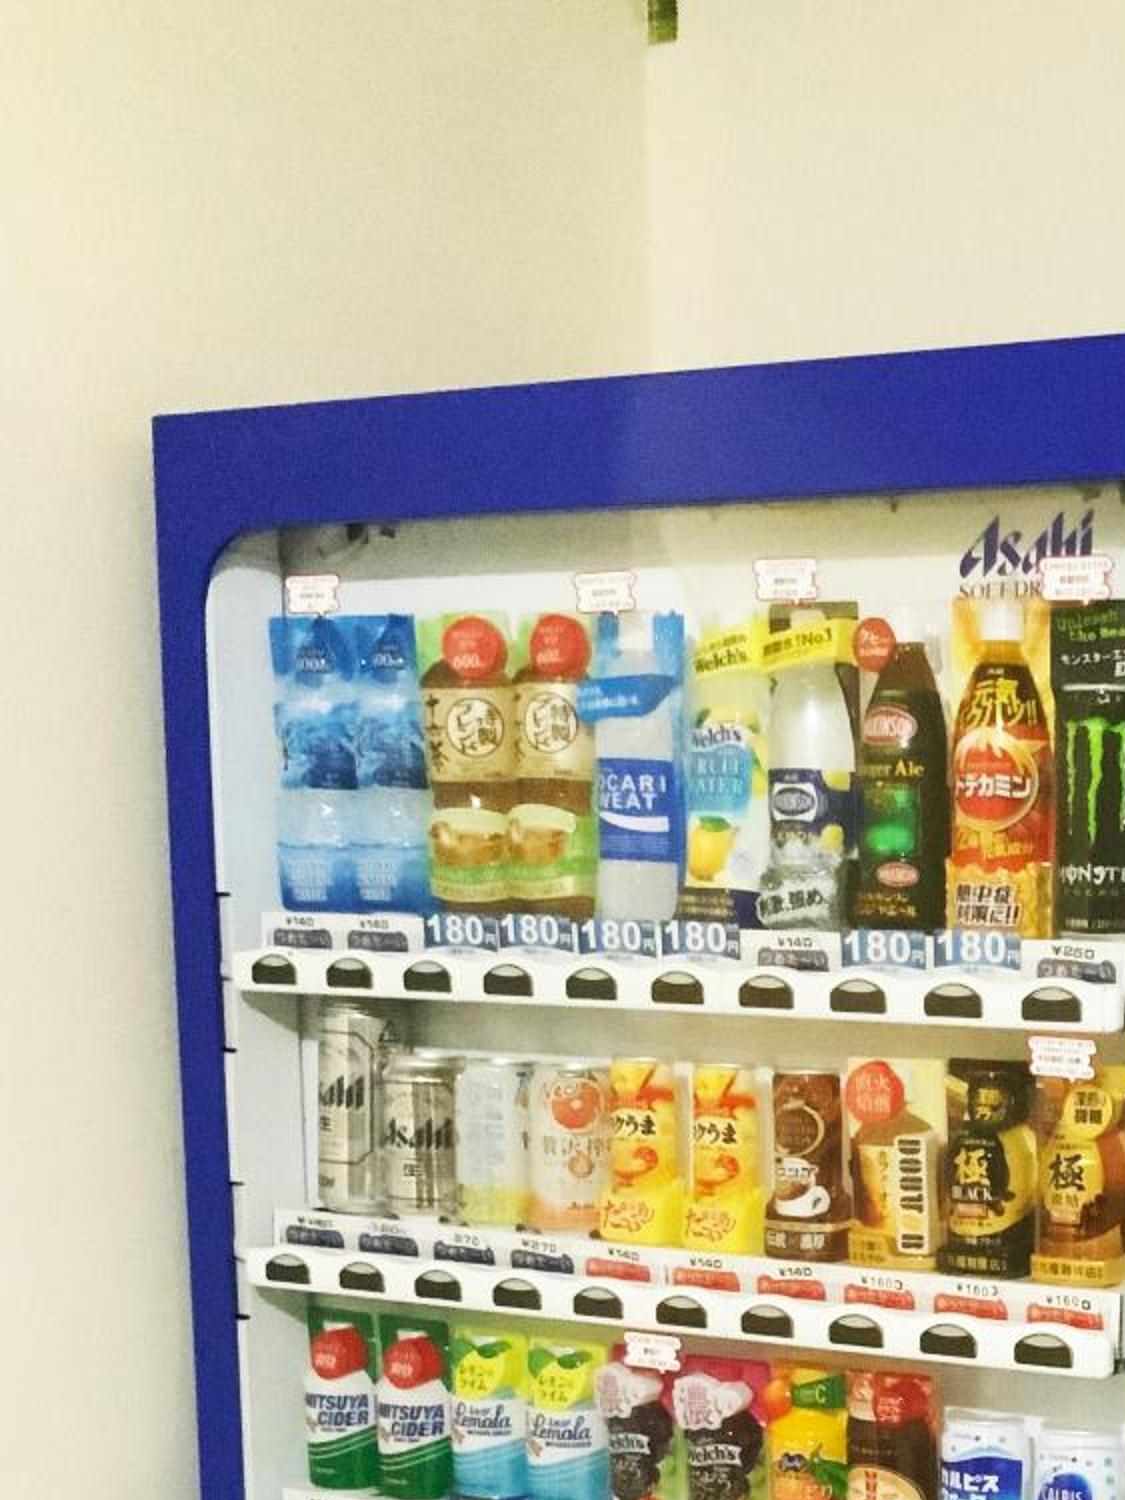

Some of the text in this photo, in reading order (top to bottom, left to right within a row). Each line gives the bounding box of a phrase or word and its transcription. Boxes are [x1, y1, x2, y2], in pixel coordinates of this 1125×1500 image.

[959, 507, 1095, 579] Asahi
[600, 773, 667, 793] CARI
[1049, 1153, 1086, 1192] 極
[317, 1410, 369, 1427] CIDER
[391, 1421, 445, 1437] CIDER
[531, 1413, 593, 1441] Lemola
